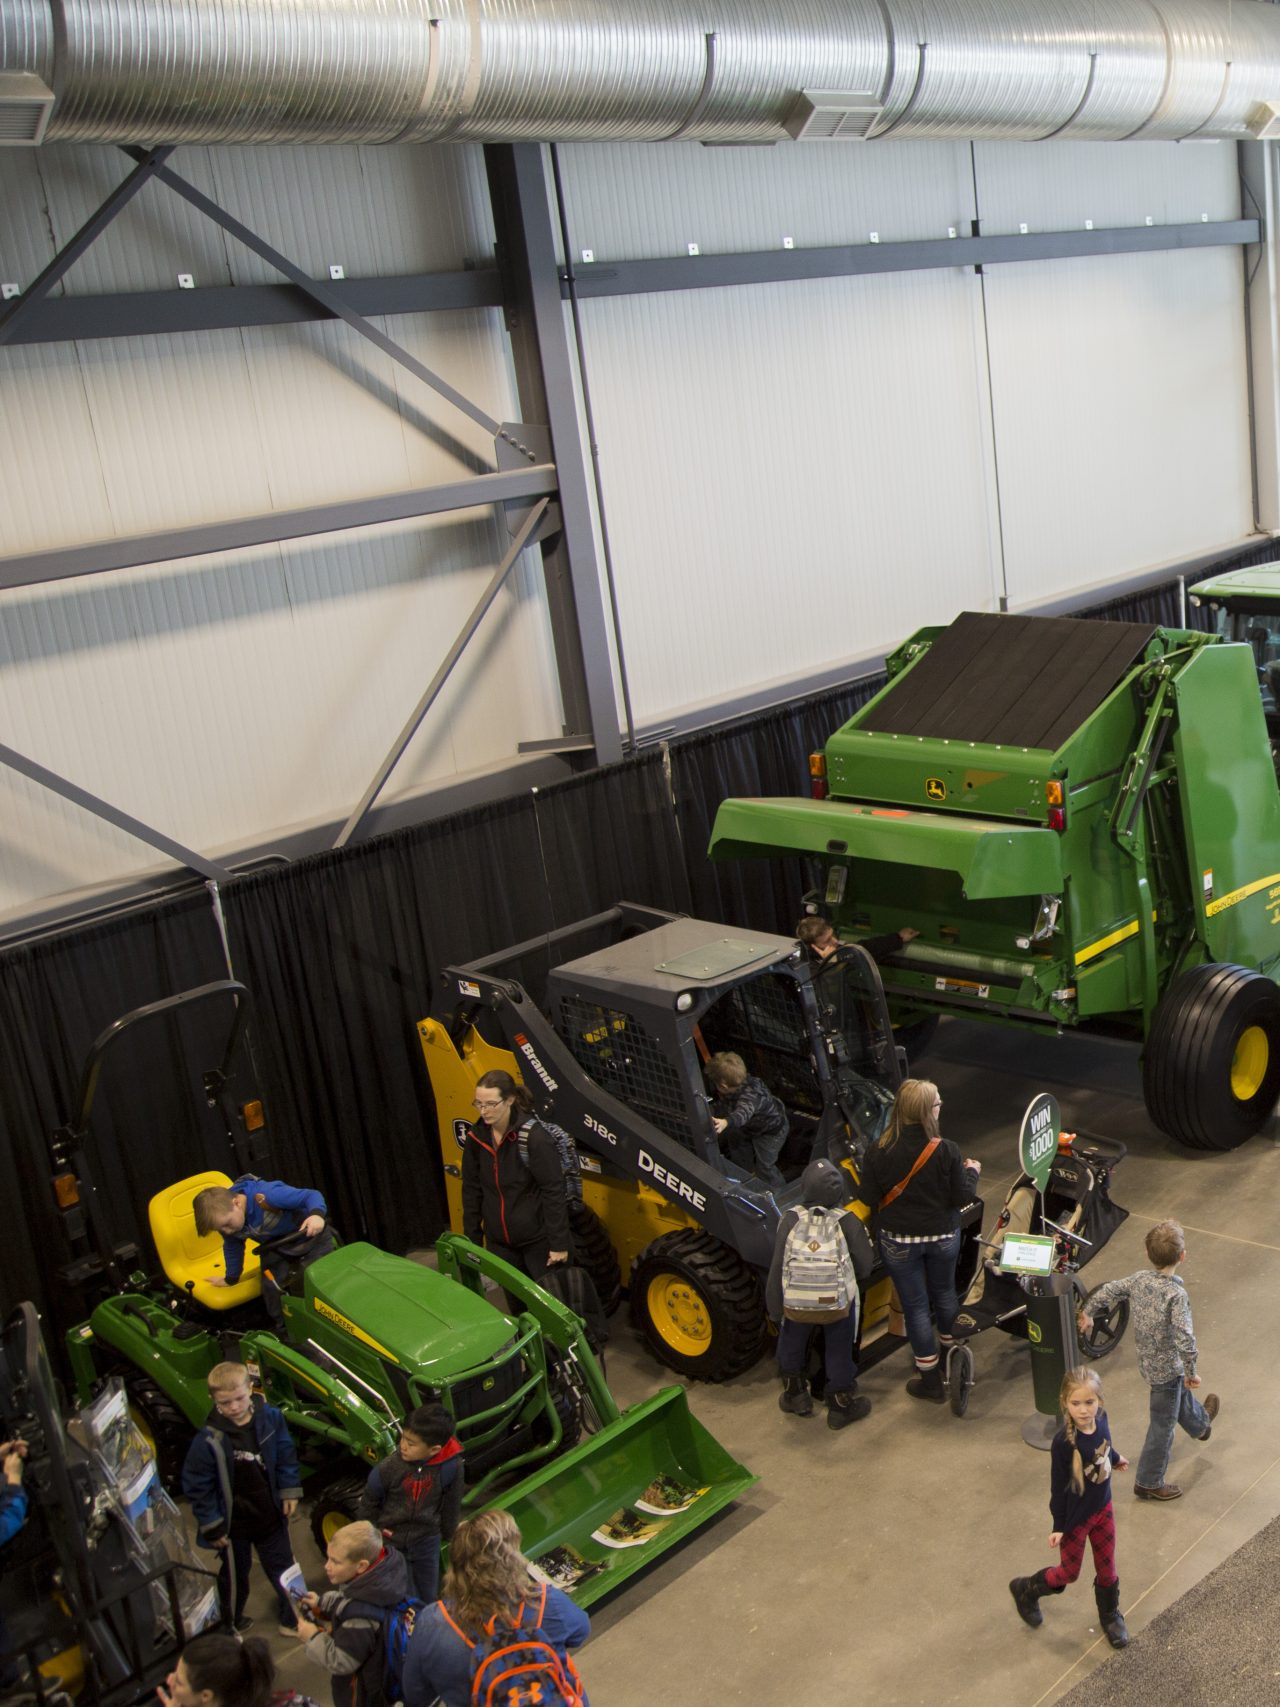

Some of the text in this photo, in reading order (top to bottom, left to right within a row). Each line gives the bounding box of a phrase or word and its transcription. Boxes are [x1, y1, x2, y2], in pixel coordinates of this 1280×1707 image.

[1211, 889, 1247, 914] JOHN DEERE
[520, 1043, 559, 1092] Brandt
[583, 1113, 617, 1145] 318G
[1030, 1105, 1051, 1135] WIN
[638, 1149, 706, 1211] DEERE
[319, 1304, 355, 1332] JOHN DEERE
